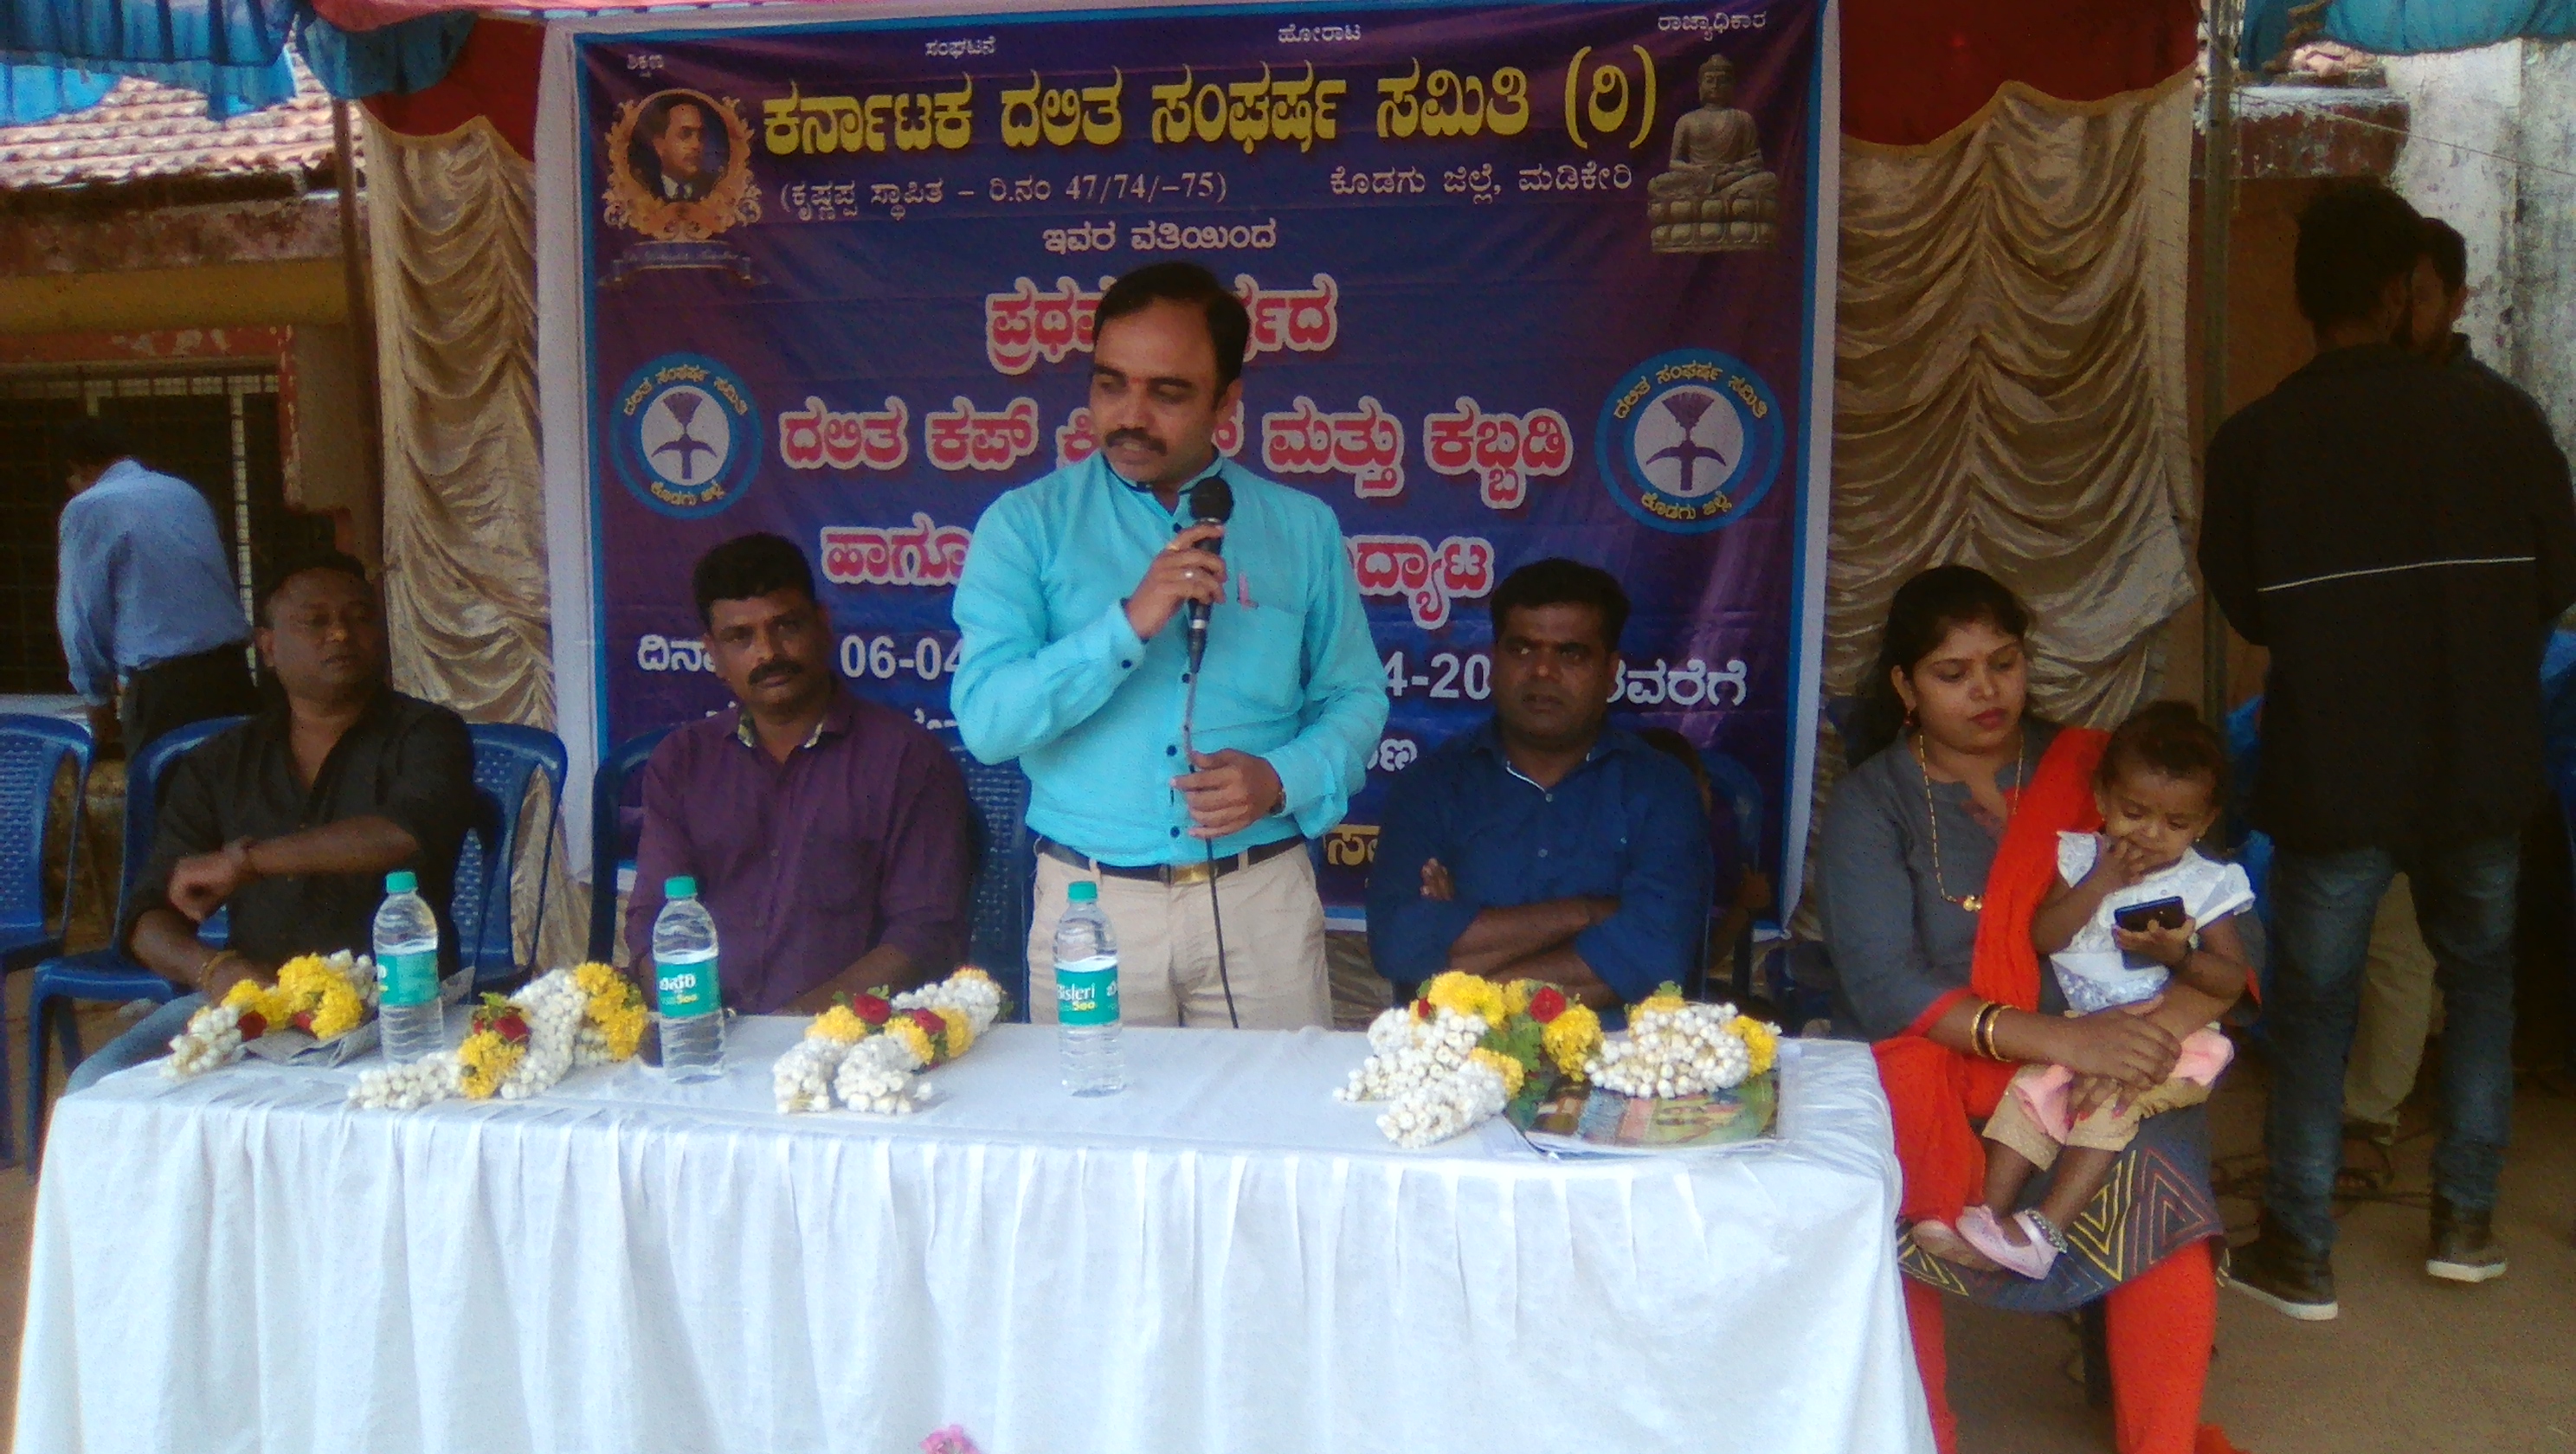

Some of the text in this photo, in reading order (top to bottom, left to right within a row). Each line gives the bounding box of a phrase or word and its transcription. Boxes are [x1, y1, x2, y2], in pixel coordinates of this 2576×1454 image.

[925, 35, 996, 59] ಸಂಘಟನೆ
[1278, 23, 1361, 42] ಹೋರಾಟ
[763, 44, 1657, 156] ಕರ್ನಾಟಕ ದಲಿತ ಸಂಘರ್ಷ ಸಮಿತಿ (ರಿ)
[1330, 165, 1426, 194] ಕೊಡಗು
[1518, 160, 1633, 190] ಮಡಿಕೇರಿ
[1042, 216, 1277, 255] ಇವರ ವತಿಯಿಂದ
[1655, 359, 1723, 383] ಸಂಘರ್ಷ
[779, 396, 909, 470] ದಲಿತ
[924, 395, 1039, 471] ಕಪ್
[1262, 395, 1405, 499] ಮತ್ತು
[1423, 395, 1574, 510] ಕಬ್ಬಡಿ
[1343, 534, 1495, 630] ದ್ಯಾಟ
[1607, 658, 1748, 705] ವರೆಗೆ
